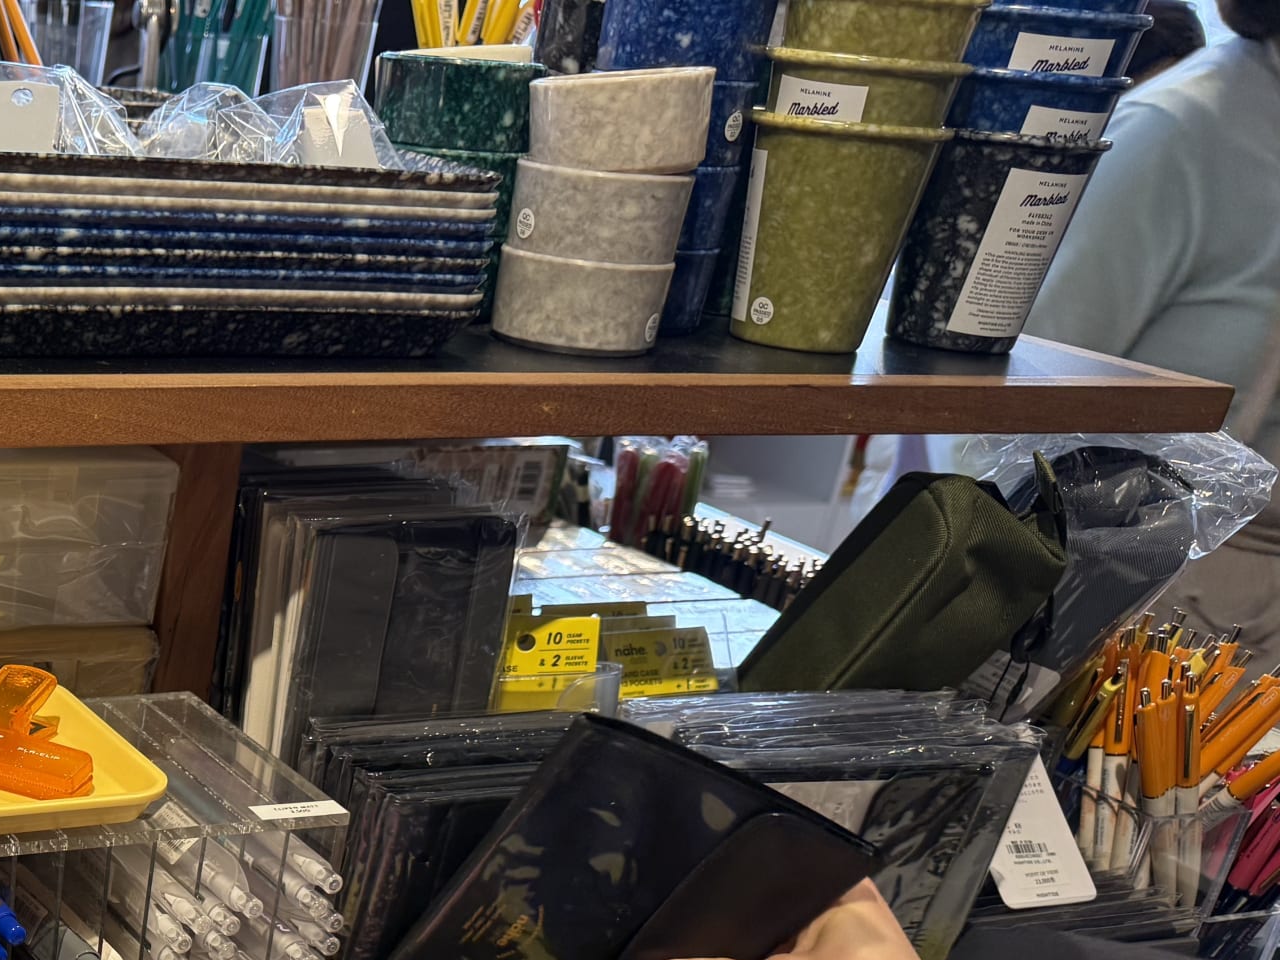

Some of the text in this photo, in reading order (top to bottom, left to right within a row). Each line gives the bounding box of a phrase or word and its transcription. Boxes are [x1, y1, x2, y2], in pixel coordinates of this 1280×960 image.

[1031, 56, 1091, 71] Marbled
[800, 88, 832, 97] MELAMINE
[787, 102, 839, 115] Marbled
[1020, 191, 1070, 207] Marbled
[547, 632, 563, 645] 10
[552, 655, 561, 667] 2
